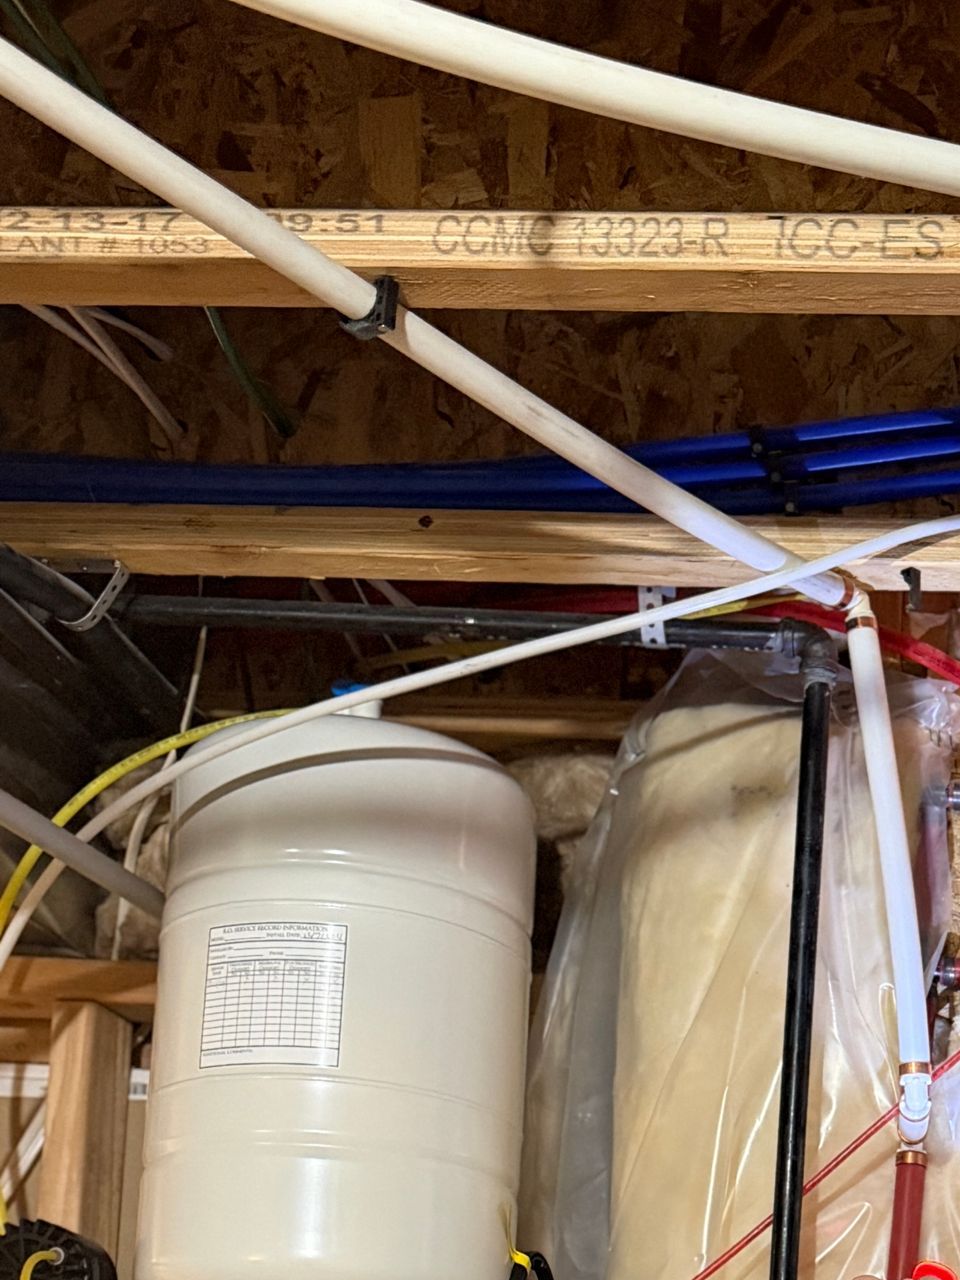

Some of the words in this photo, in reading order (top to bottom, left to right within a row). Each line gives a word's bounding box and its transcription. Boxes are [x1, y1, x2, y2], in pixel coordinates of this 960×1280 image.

[433, 214, 556, 256] CCMC
[572, 216, 730, 257] 13323-R
[772, 217, 945, 260] ICC-ES
